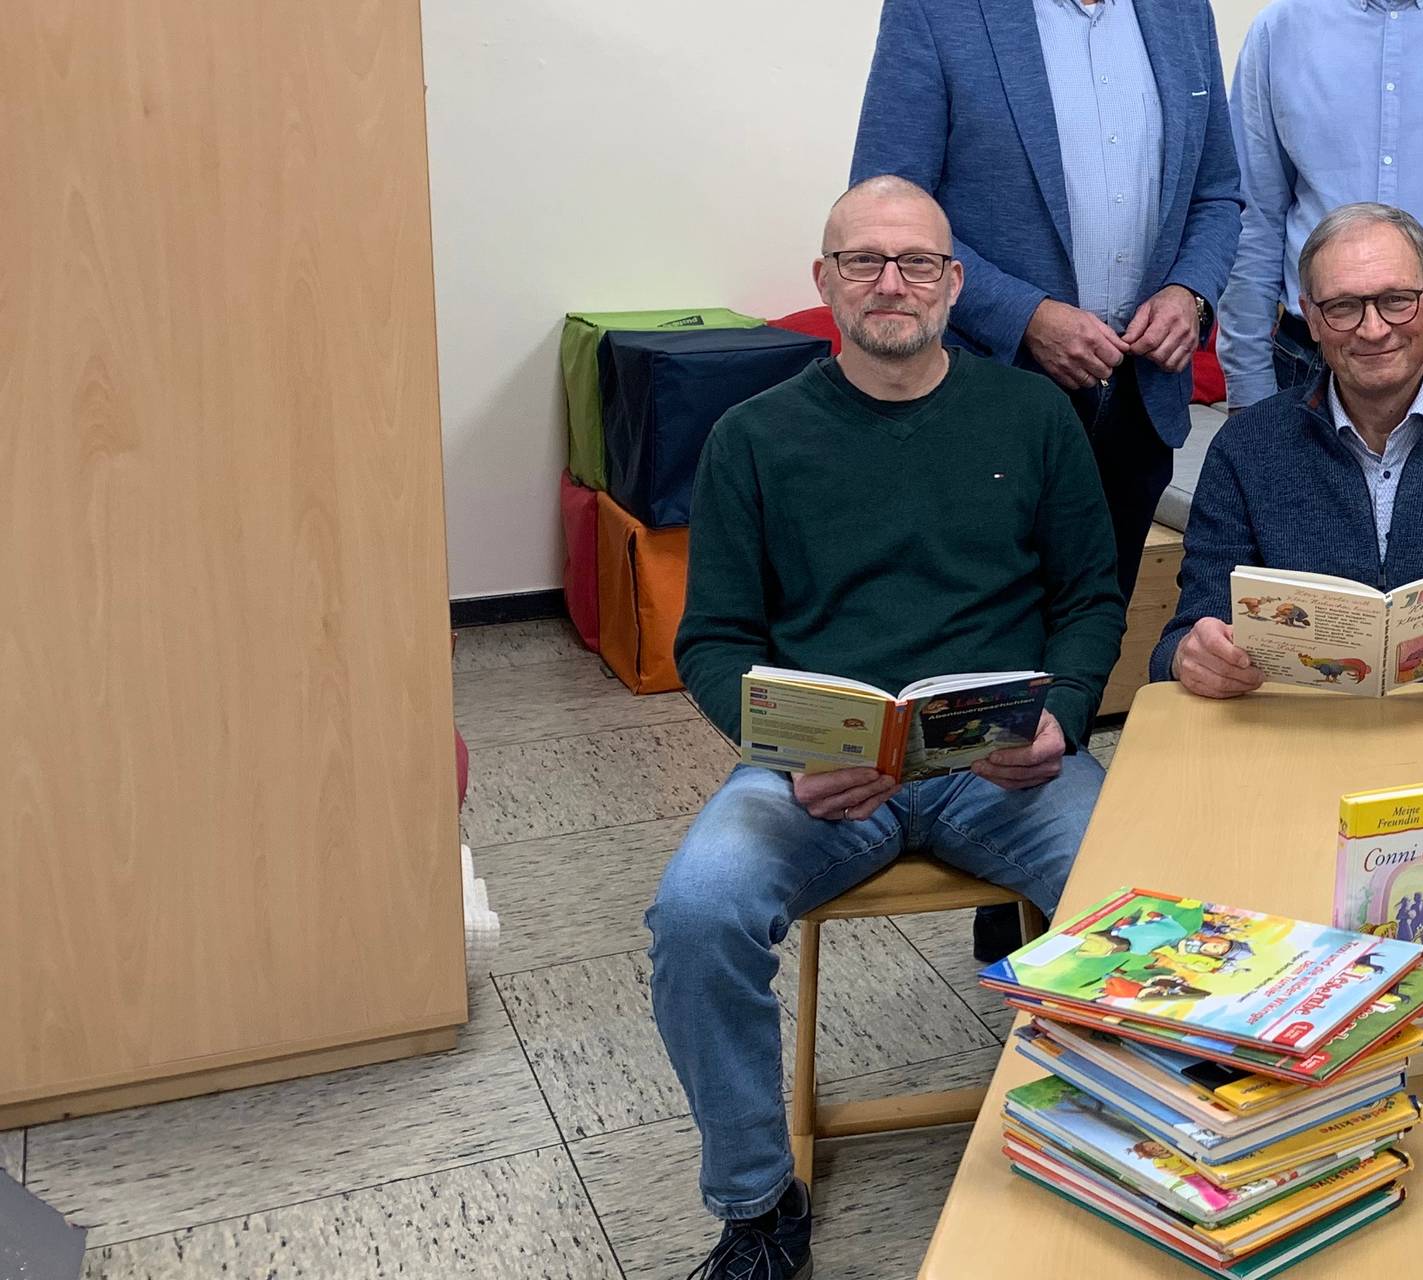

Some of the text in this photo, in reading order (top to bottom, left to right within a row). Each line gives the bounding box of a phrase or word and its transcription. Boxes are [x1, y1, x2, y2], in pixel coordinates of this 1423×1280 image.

[928, 698, 1036, 720] Abenteuergeschichten
[1377, 814, 1420, 829] Freundin
[1392, 806, 1421, 818] Meine
[1363, 843, 1418, 872] Conni
[1294, 972, 1367, 1016] Leserabe
